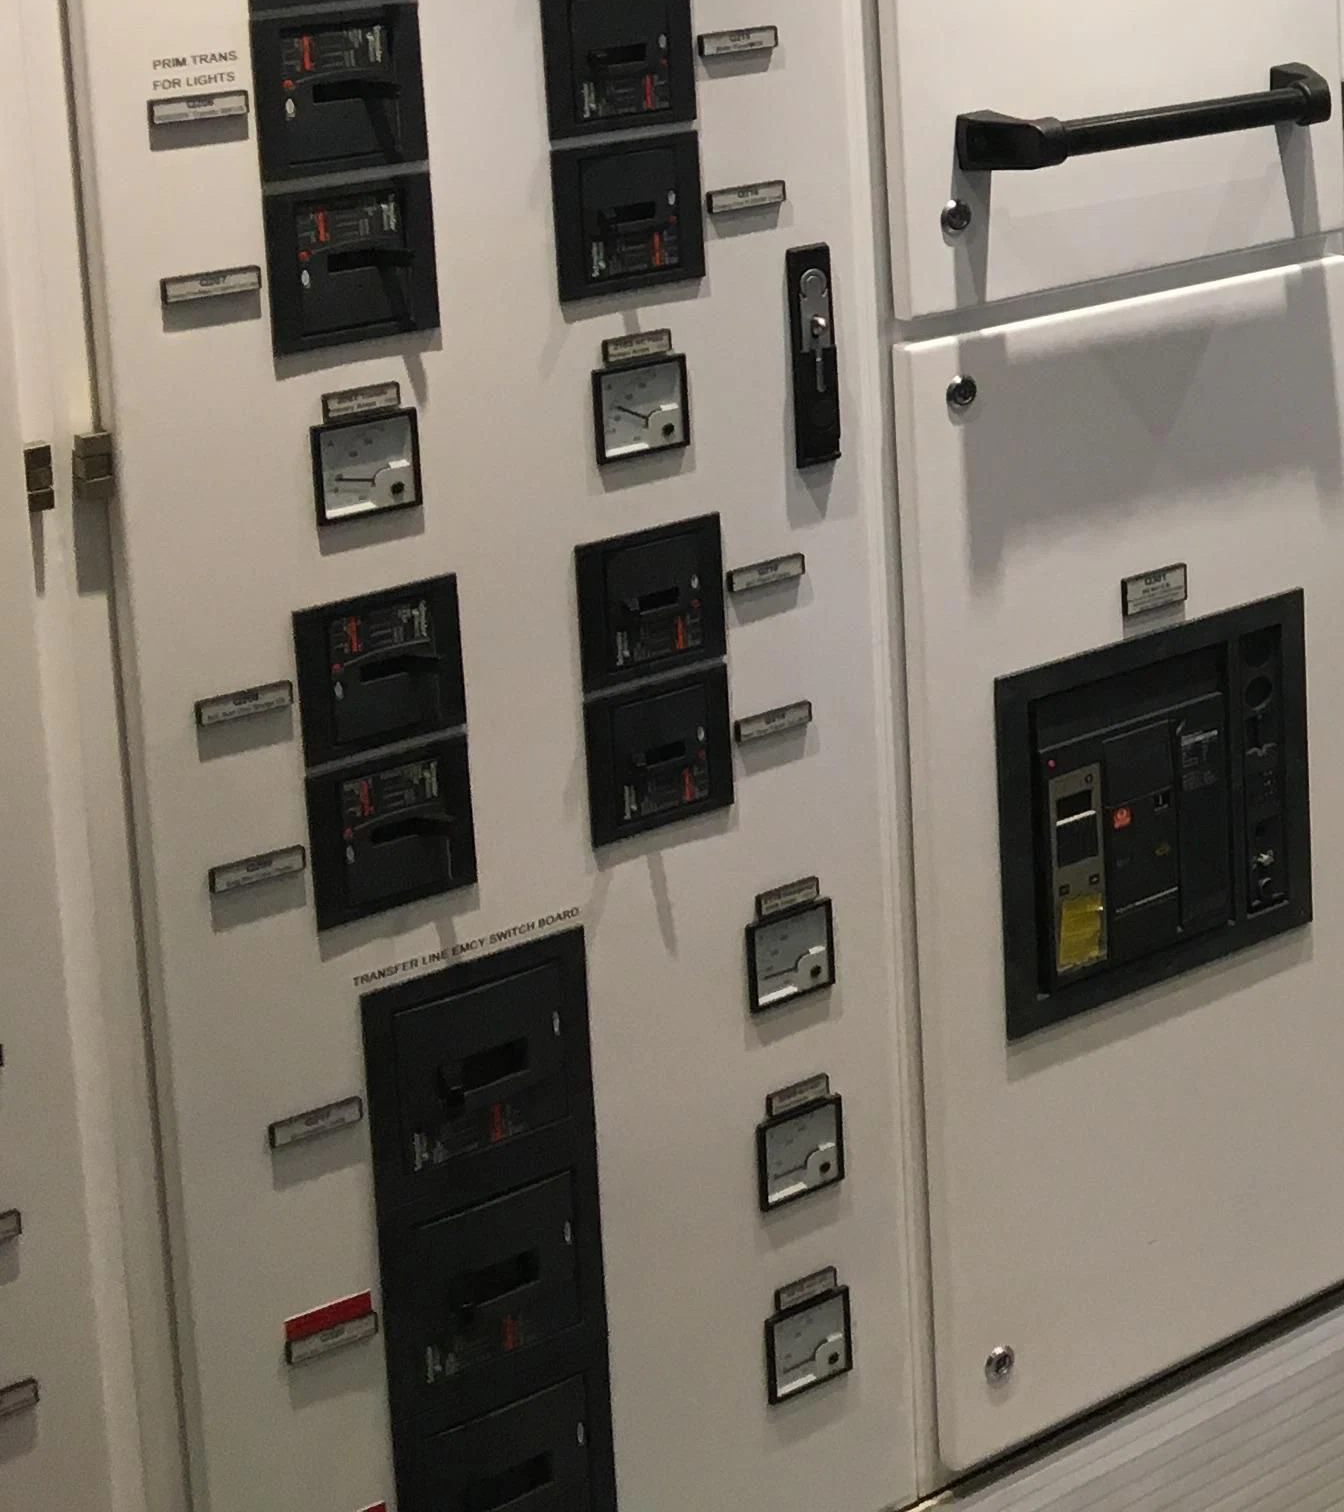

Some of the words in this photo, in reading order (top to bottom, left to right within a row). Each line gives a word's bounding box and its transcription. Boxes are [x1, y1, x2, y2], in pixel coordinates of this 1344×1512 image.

[152, 56, 187, 71] PRIM
[192, 50, 238, 67] TRANS
[152, 78, 182, 91] FOR
[186, 71, 236, 88] LIGHTS
[352, 958, 420, 988] TRANSFER
[421, 948, 450, 968] LINE
[451, 937, 487, 960] EMCY
[488, 920, 536, 946] SWITCH
[537, 906, 581, 931] BOARD
